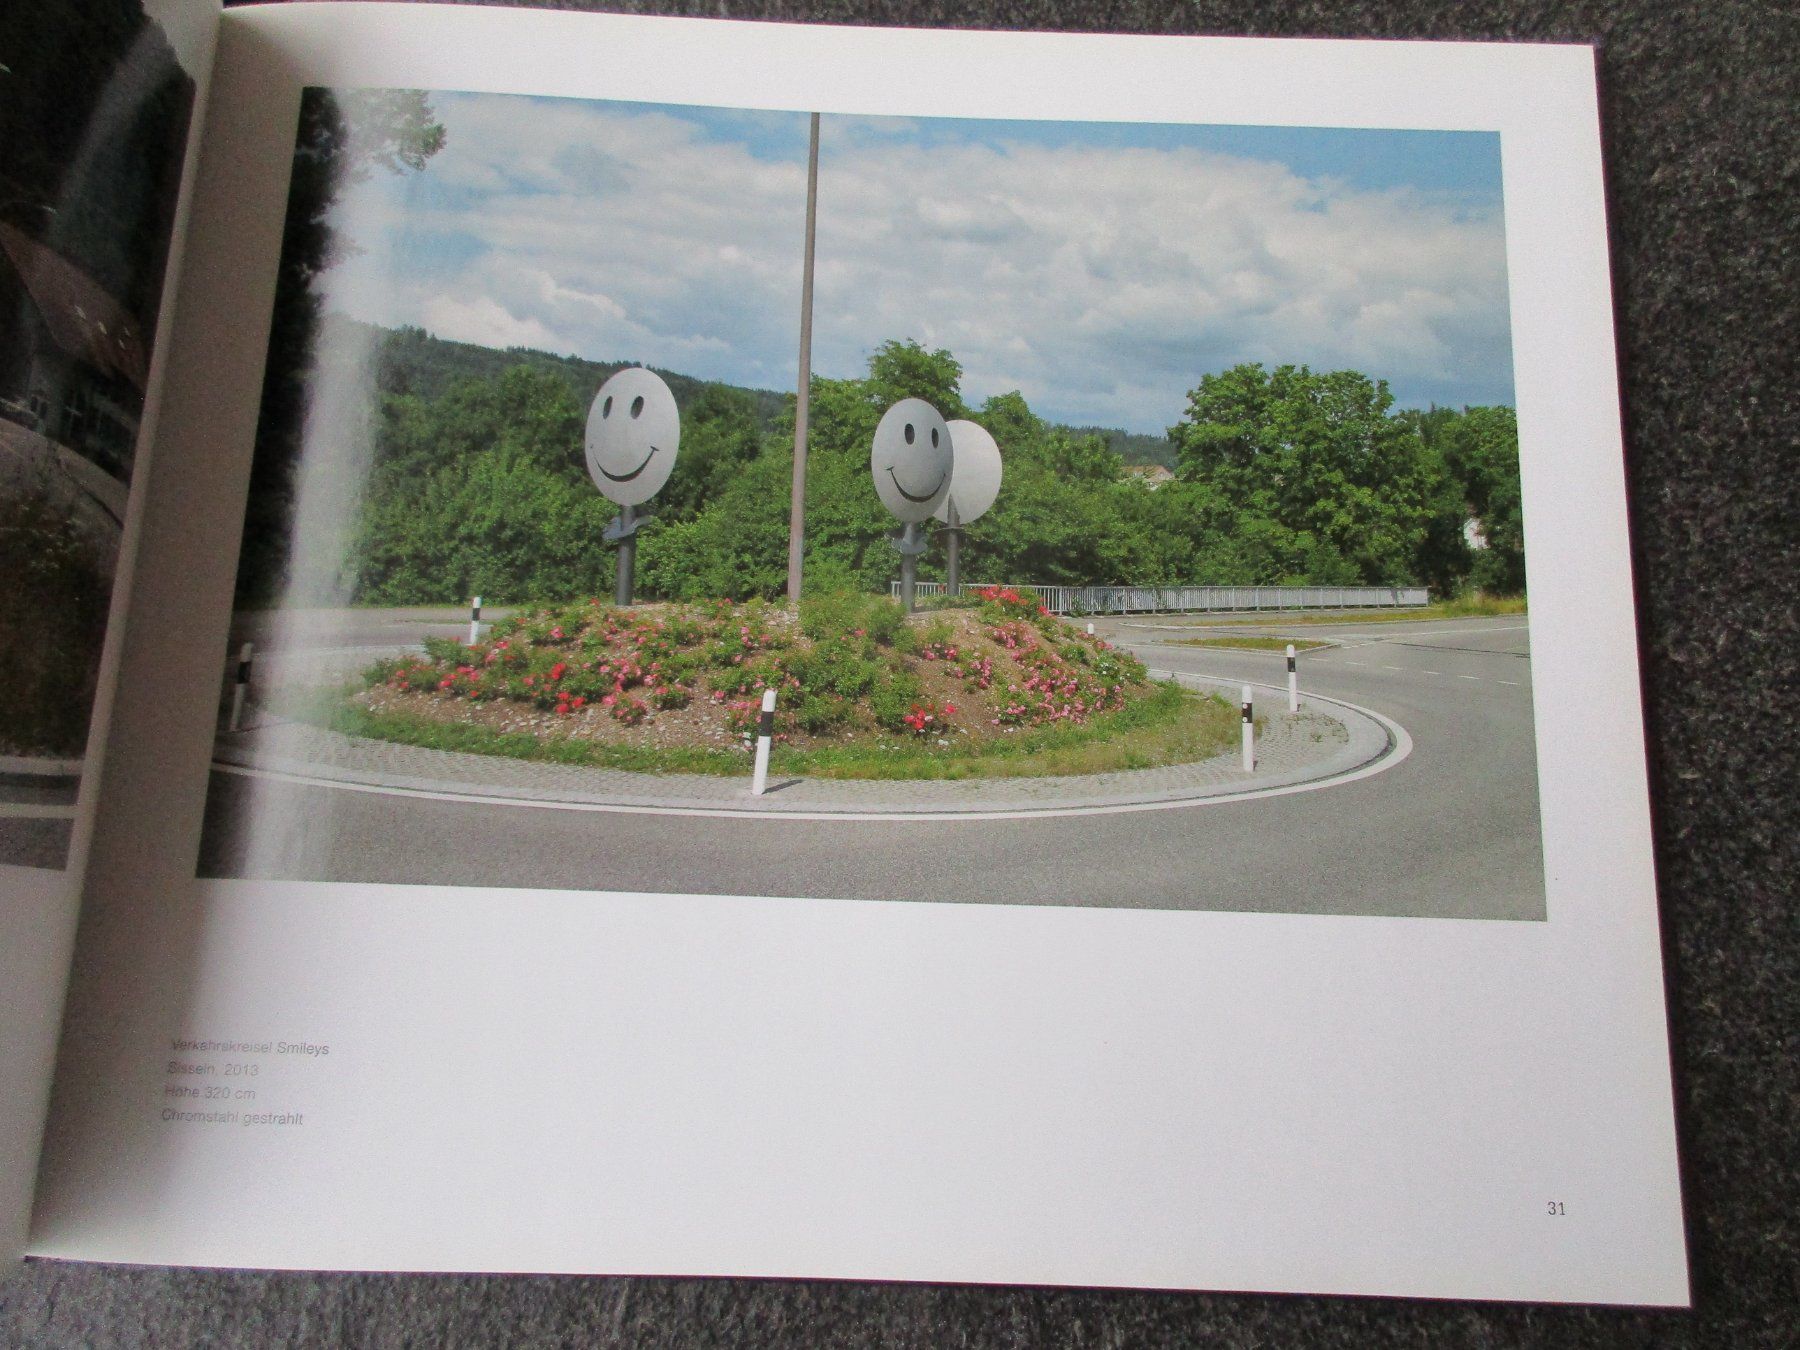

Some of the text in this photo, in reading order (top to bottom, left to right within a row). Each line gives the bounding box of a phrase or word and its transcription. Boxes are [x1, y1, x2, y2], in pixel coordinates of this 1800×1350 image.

[277, 1041, 330, 1057] Smileys
[224, 1063, 259, 1076] 2013
[205, 1086, 231, 1100] 320
[234, 1089, 257, 1100] cm
[161, 1108, 304, 1127] Chromstahl gestrahlt
[1547, 1201, 1566, 1216] 31
